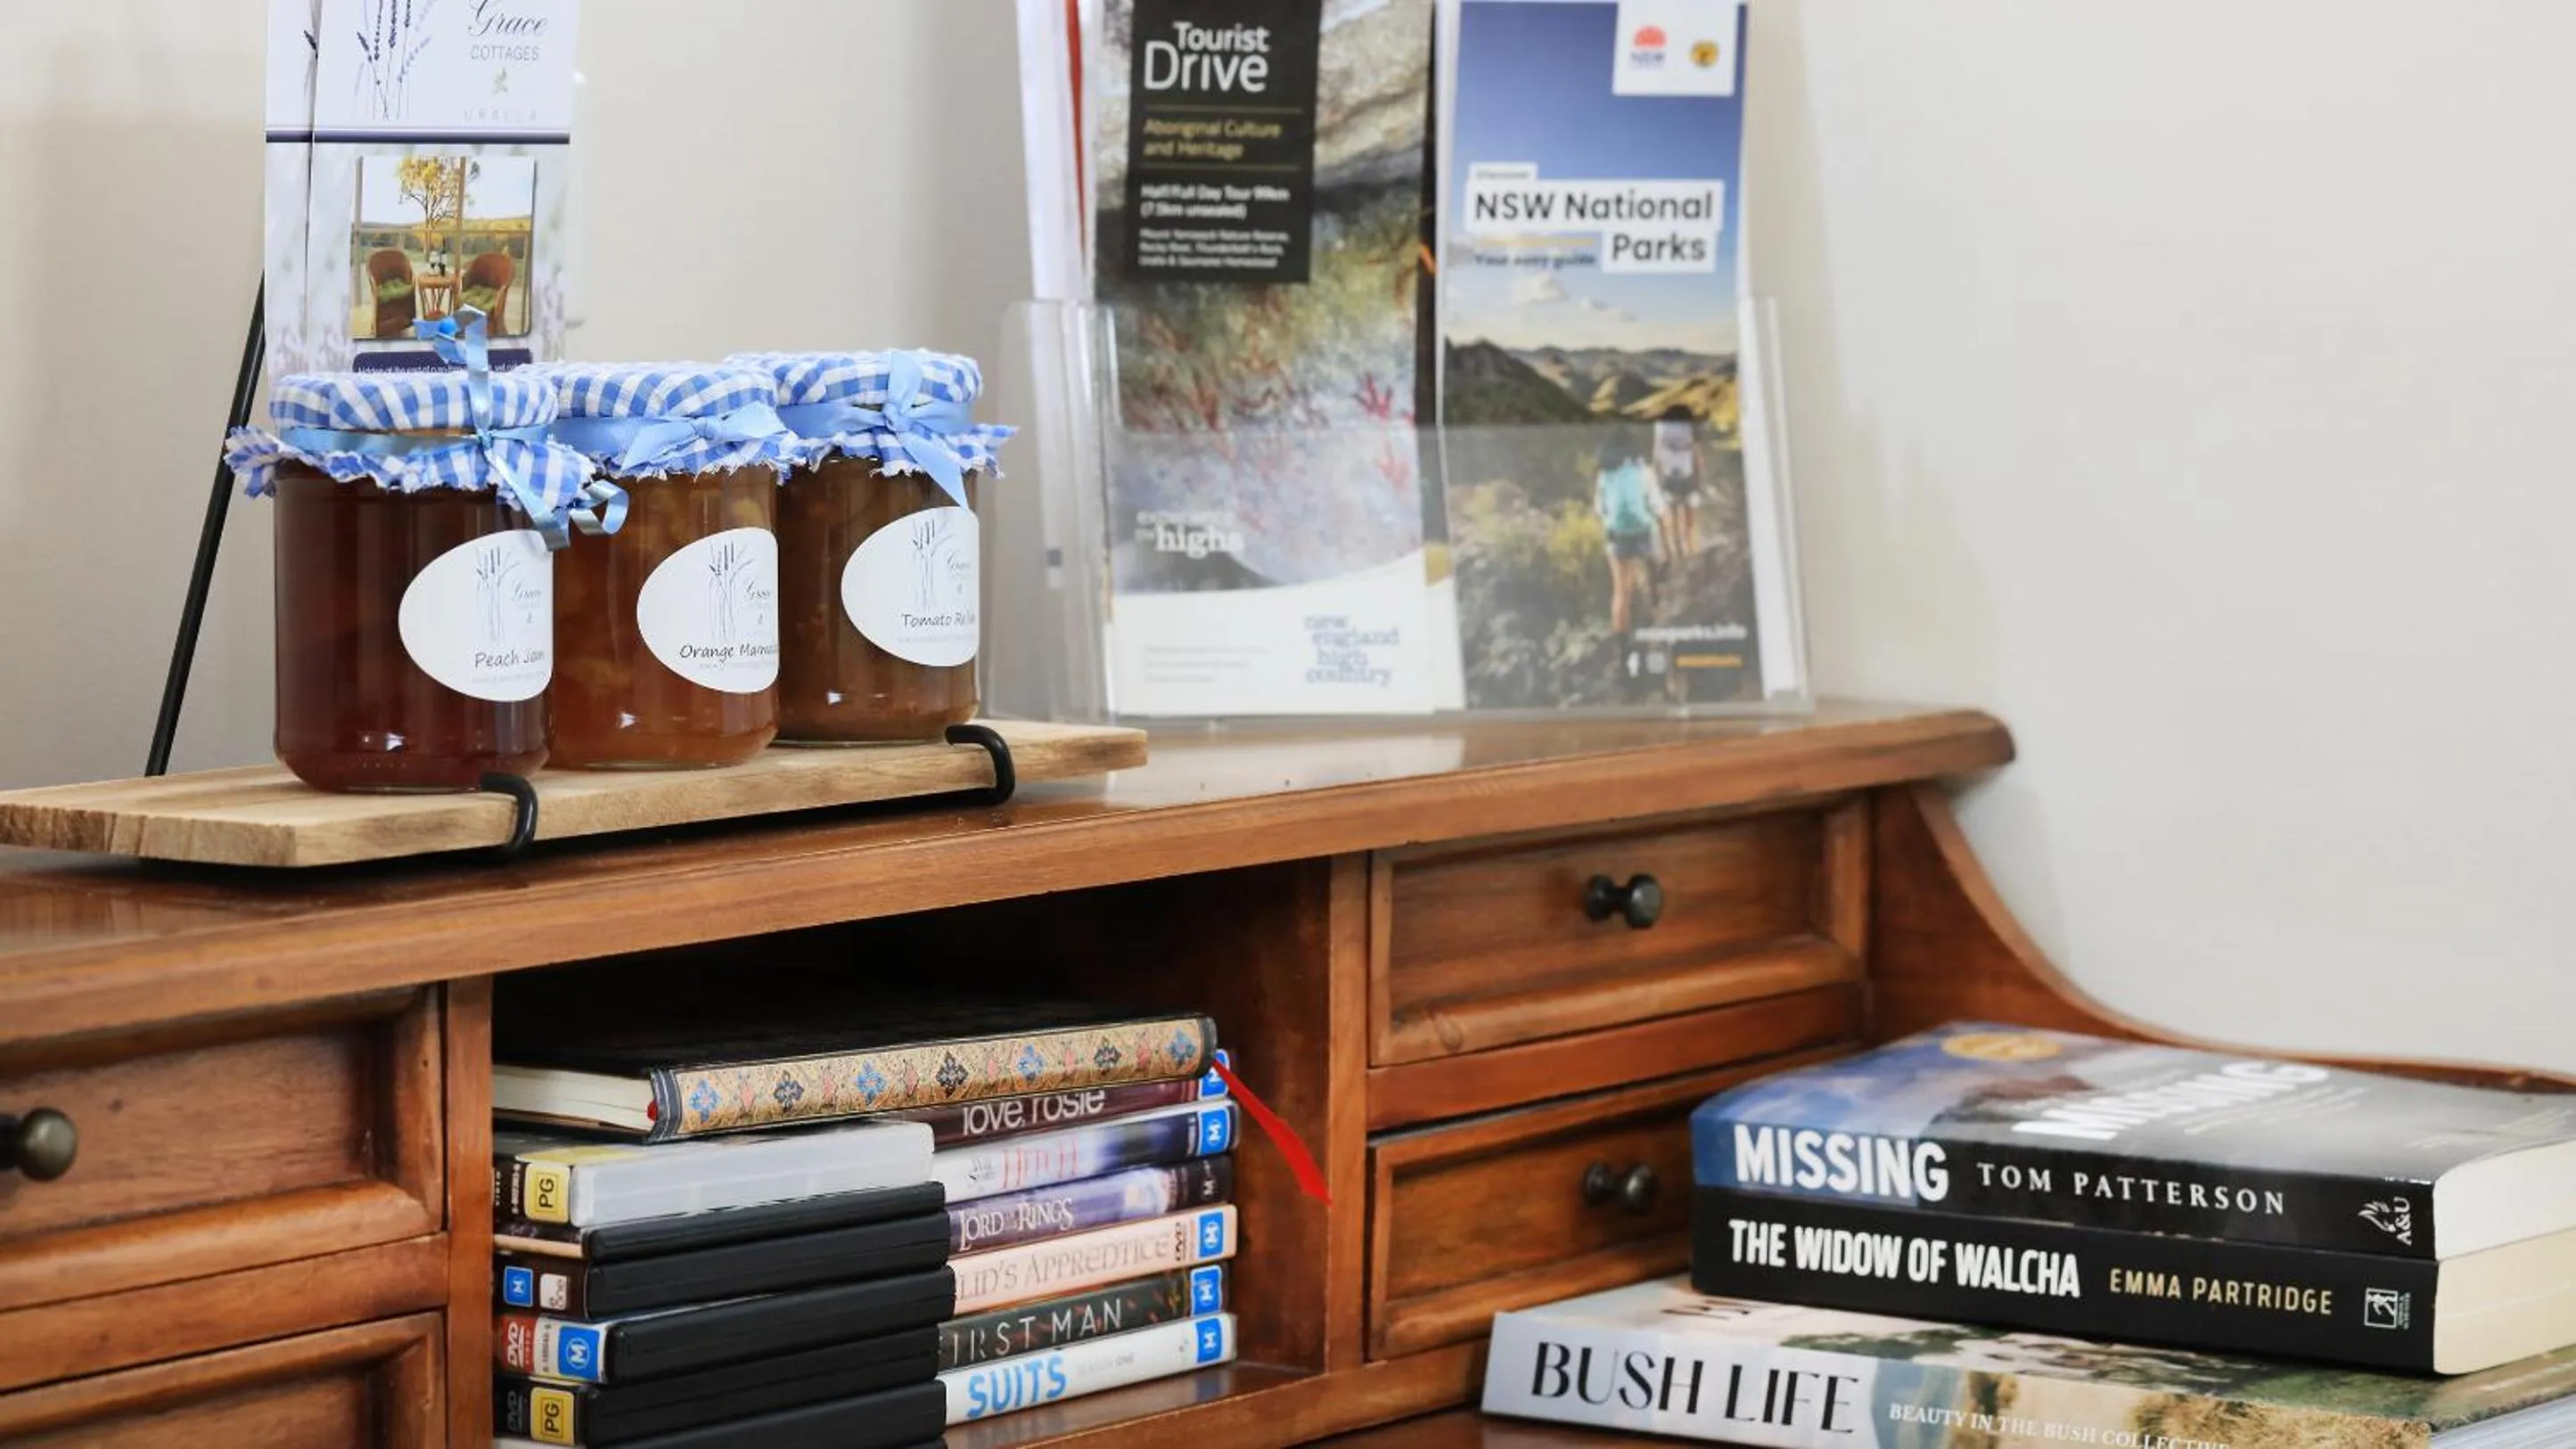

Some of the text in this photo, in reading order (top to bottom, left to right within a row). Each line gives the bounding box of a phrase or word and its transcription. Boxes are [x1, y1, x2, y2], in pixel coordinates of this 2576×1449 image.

[470, 45, 540, 61] COTTAGES
[1172, 21, 1270, 53] Tourist
[1144, 40, 1269, 93] Drive
[1143, 141, 1174, 157] and
[1475, 188, 1712, 221] NSW National
[1612, 233, 1708, 262] Parks
[900, 613, 951, 627] Tomato
[475, 649, 519, 668] Peach
[679, 644, 734, 663] Orange
[1031, 1089, 1106, 1125] rosie
[1734, 1124, 2285, 1216] MISSING TOM PATTERSON
[538, 1178, 554, 1208] PG
[957, 1198, 1075, 1253] LORD RINGS
[2393, 1196, 2413, 1247] A&U
[1728, 1218, 2081, 1299] THE WIDOW OF WALCHA
[2109, 1268, 2333, 1315] EMMA PARTRIDGE
[507, 1322, 521, 1368] DVD
[939, 1297, 1121, 1366] IRST MAN
[966, 1354, 1067, 1419] SUITS
[1530, 1341, 1859, 1434] BUSH LIFE
[545, 1403, 561, 1433] PG
[1889, 1403, 1967, 1428] BEAUTY
[1971, 1412, 1993, 1429] IN
[1998, 1417, 2037, 1437] THE
[2044, 1421, 2096, 1444] BUSH
